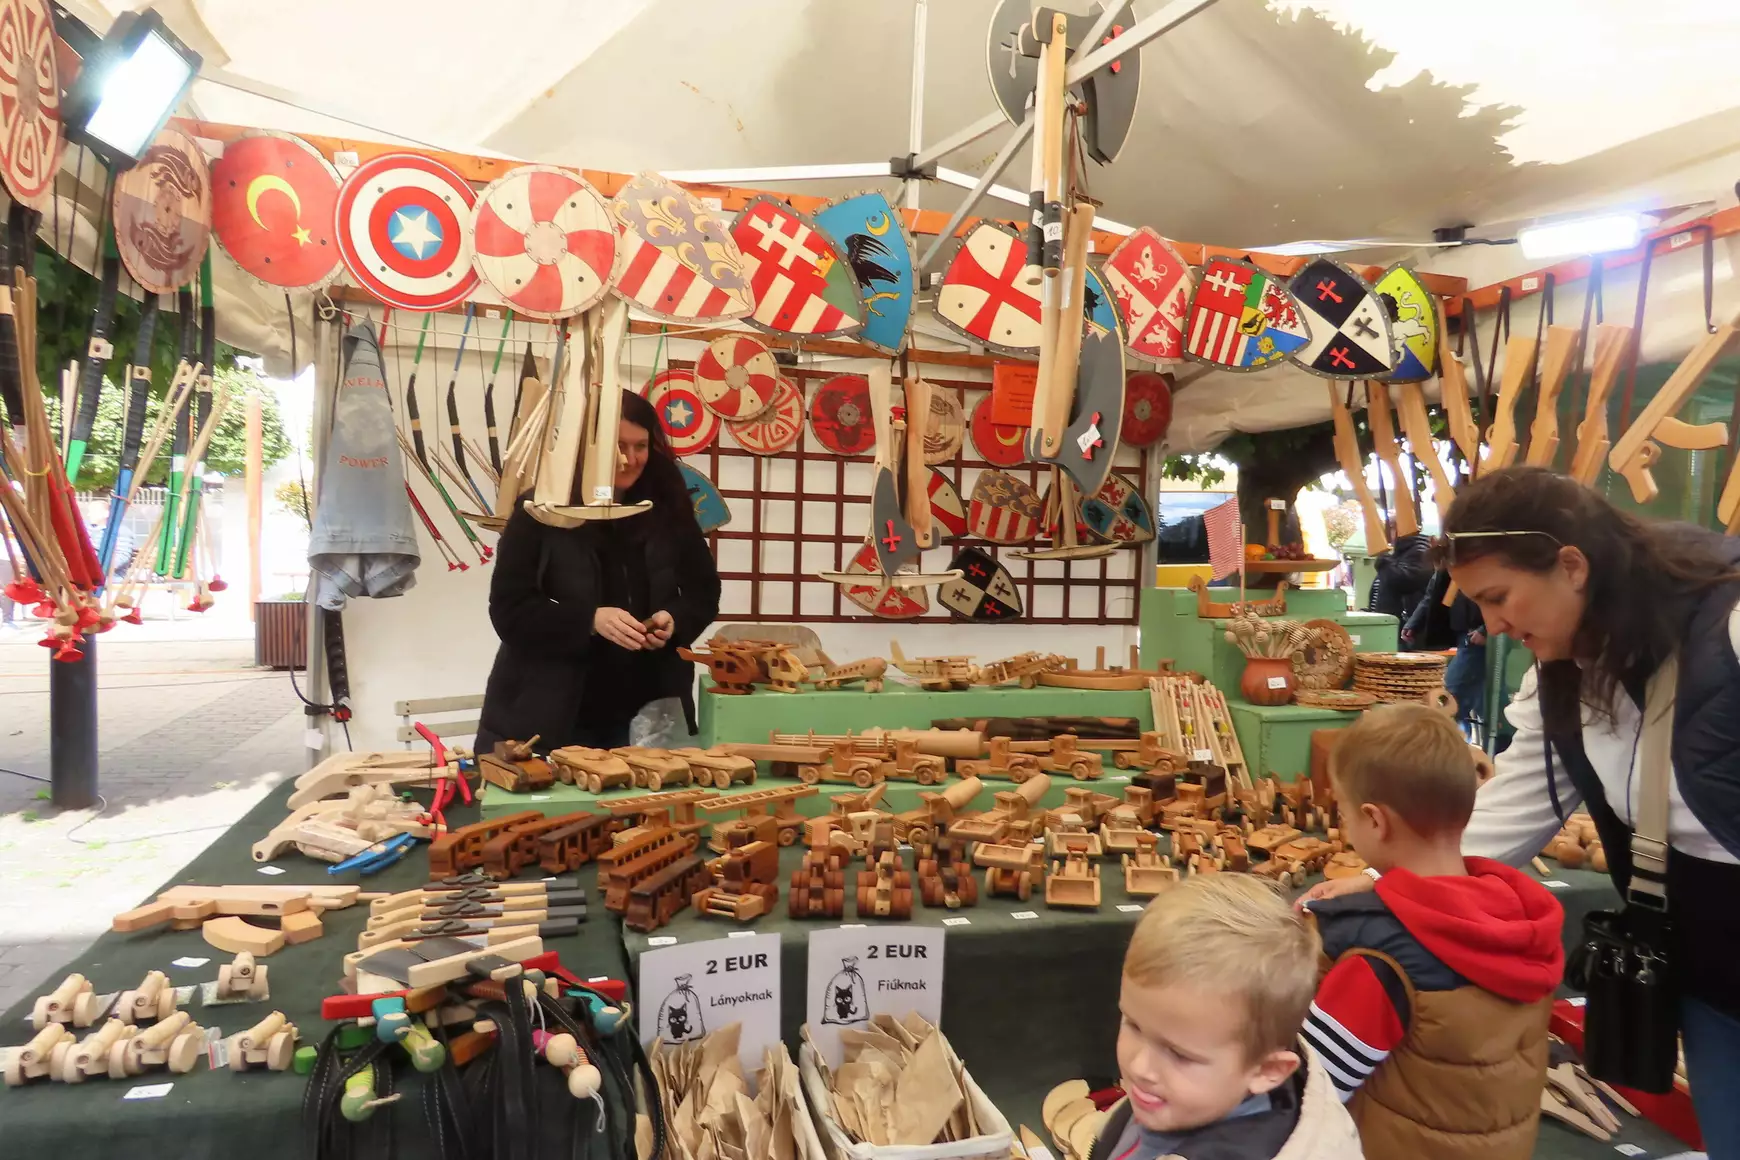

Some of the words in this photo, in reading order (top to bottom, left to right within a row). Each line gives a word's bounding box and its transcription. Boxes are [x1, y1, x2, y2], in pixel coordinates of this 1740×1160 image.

[339, 454, 389, 469] POWER
[867, 945, 879, 959] 2
[885, 944, 928, 959] EUR
[705, 959, 718, 975] 2
[725, 953, 768, 972] EUR
[877, 978, 927, 992] Fiúknak
[710, 988, 773, 1007] Lányoknak
